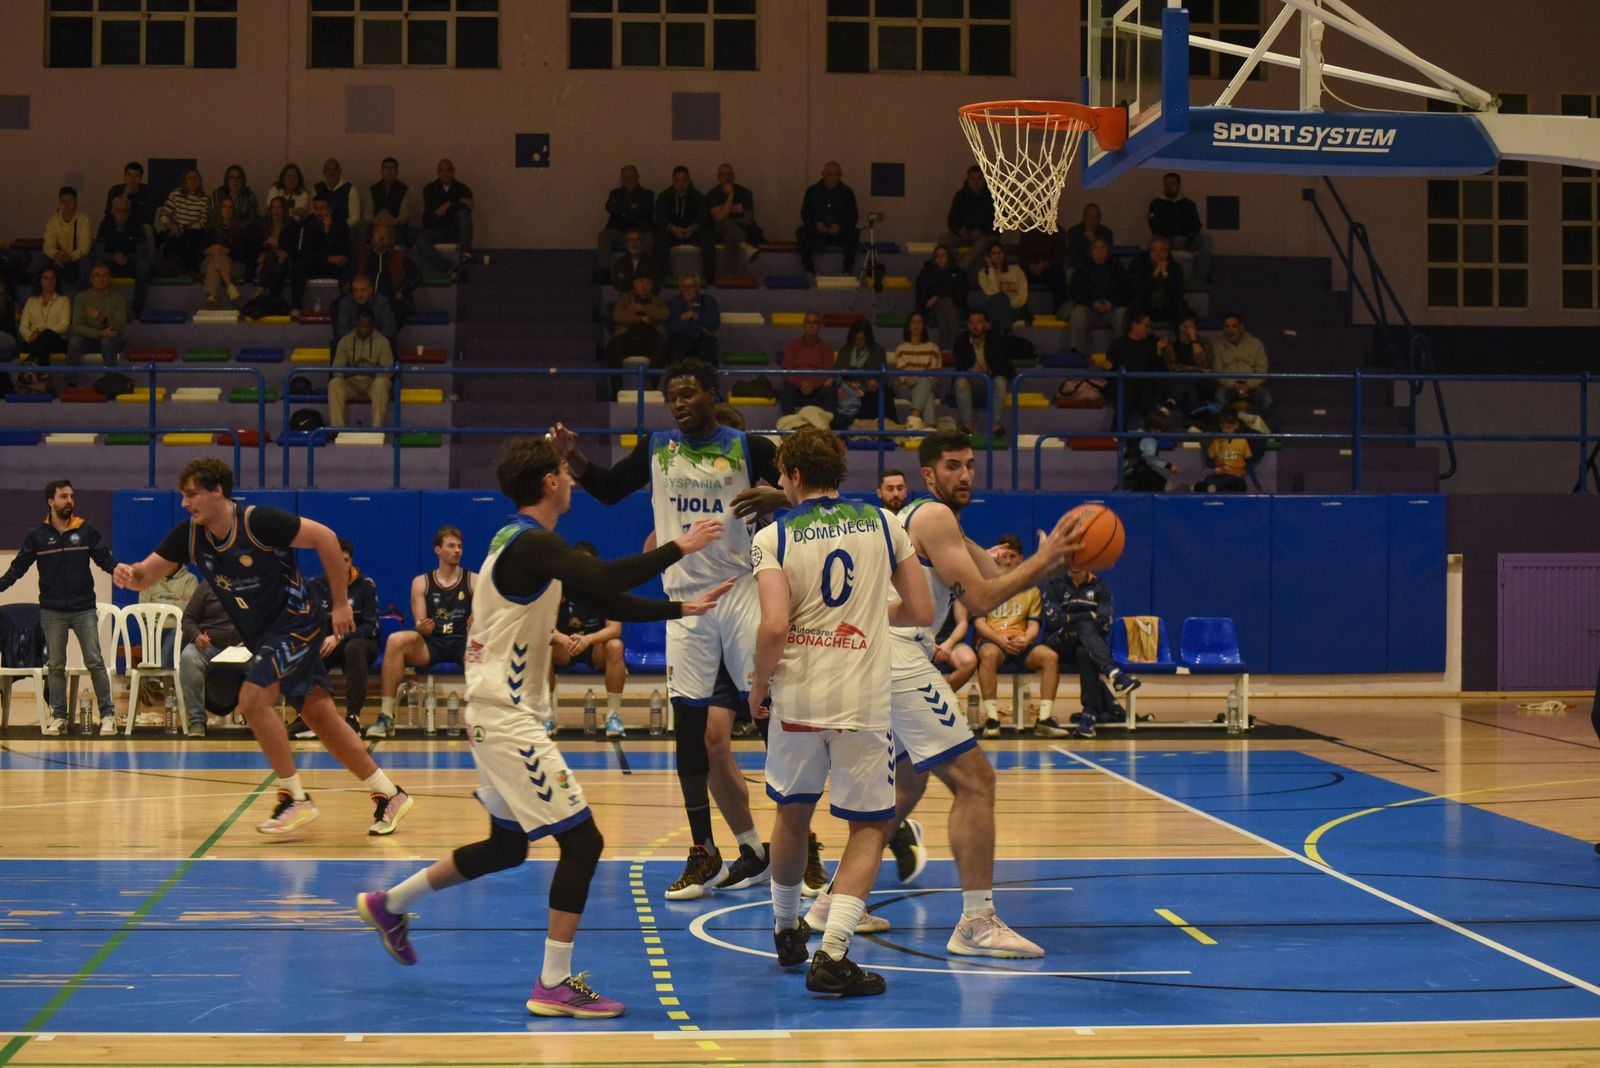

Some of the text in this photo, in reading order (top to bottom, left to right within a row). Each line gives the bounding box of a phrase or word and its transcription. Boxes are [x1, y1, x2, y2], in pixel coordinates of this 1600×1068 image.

[793, 519, 876, 543] DOMENECH
[821, 548, 854, 608] 0
[787, 632, 867, 650] BONACHELA
